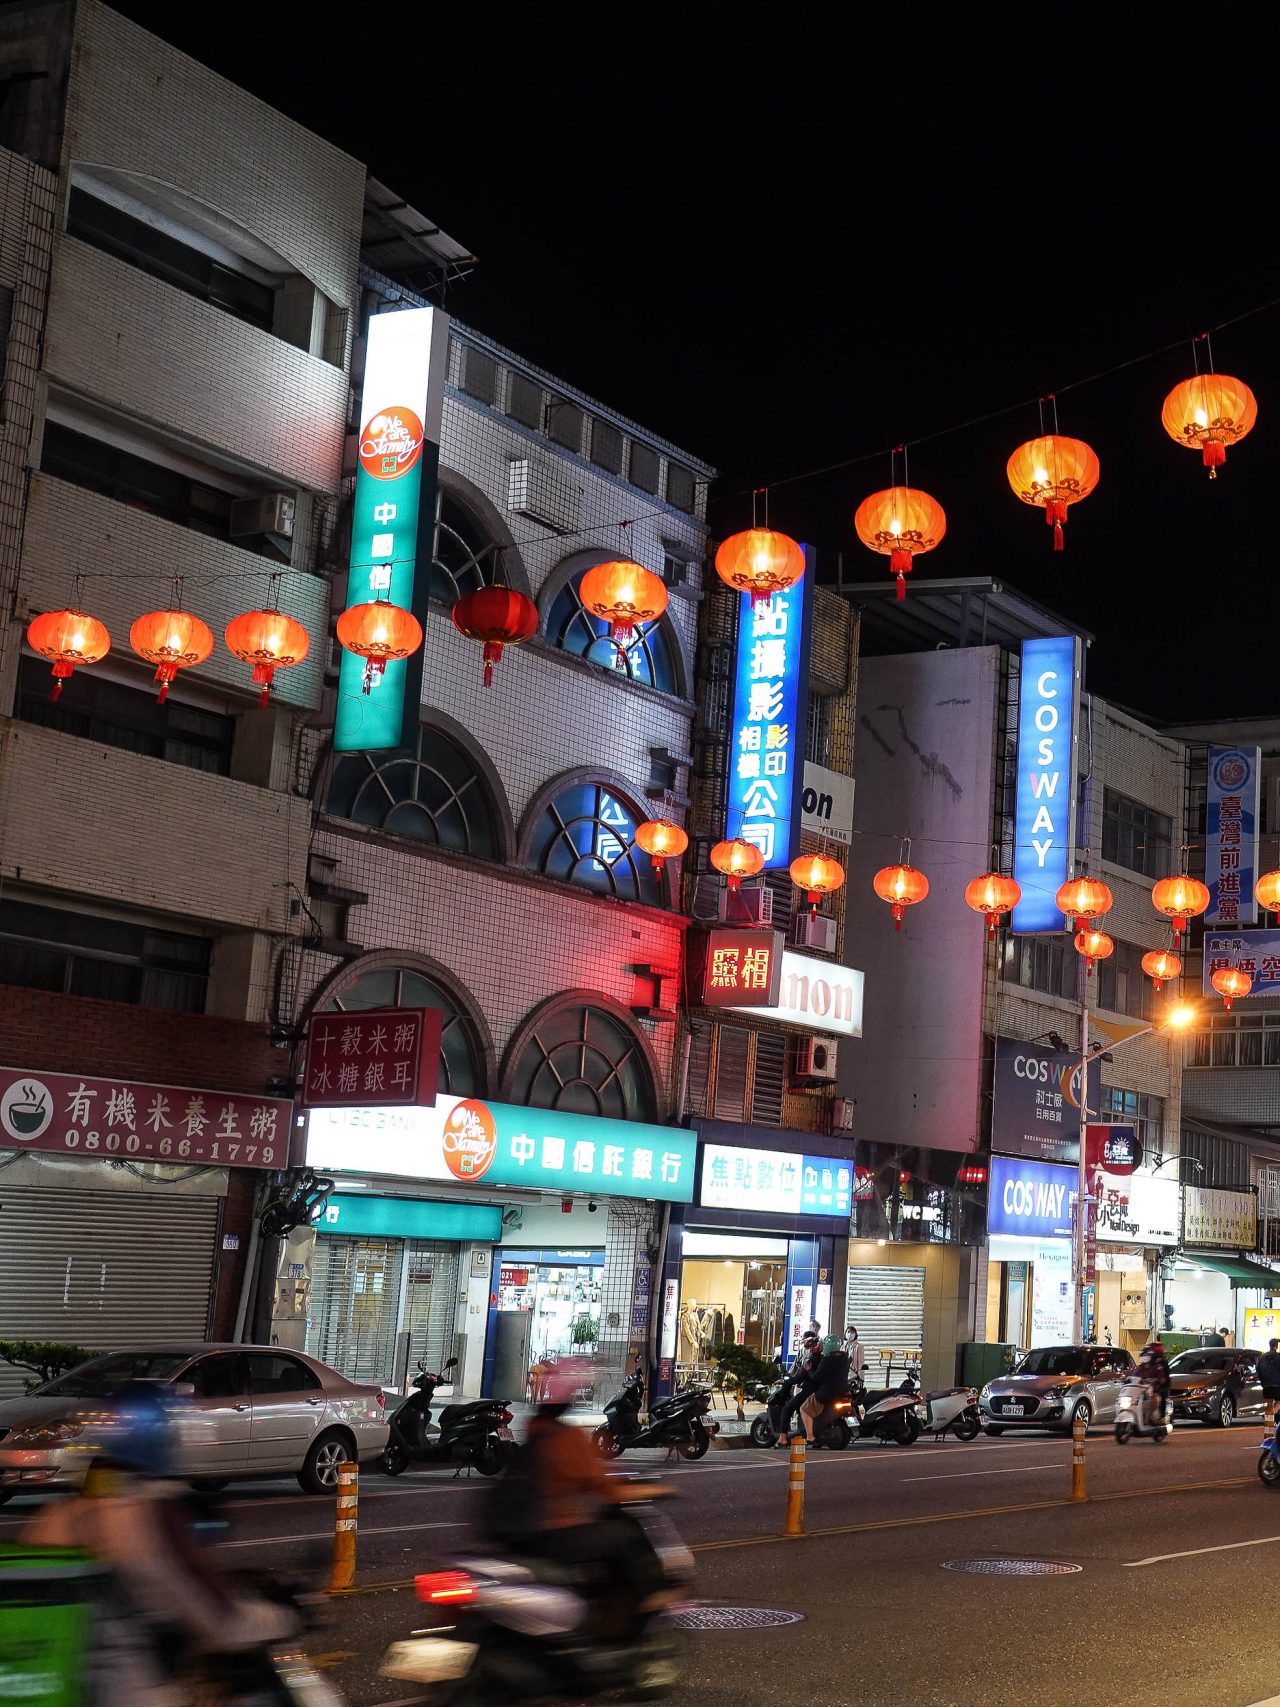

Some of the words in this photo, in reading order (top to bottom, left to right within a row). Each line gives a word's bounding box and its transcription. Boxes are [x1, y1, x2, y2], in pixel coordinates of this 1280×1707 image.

[1030, 671, 1060, 868] COSWAY
[1218, 795, 1242, 920] 臺灣前進黨
[780, 972, 853, 1022] non
[311, 1061, 412, 1094] 冰糖銀耳
[64, 1082, 279, 1142] 有機米養生粥
[1036, 1108, 1062, 1122] 日用百貨
[64, 1129, 275, 1163] 0800-66-1779
[510, 1132, 682, 1183] 中國信託銀行
[1003, 1179, 1065, 1219] COSWAY
